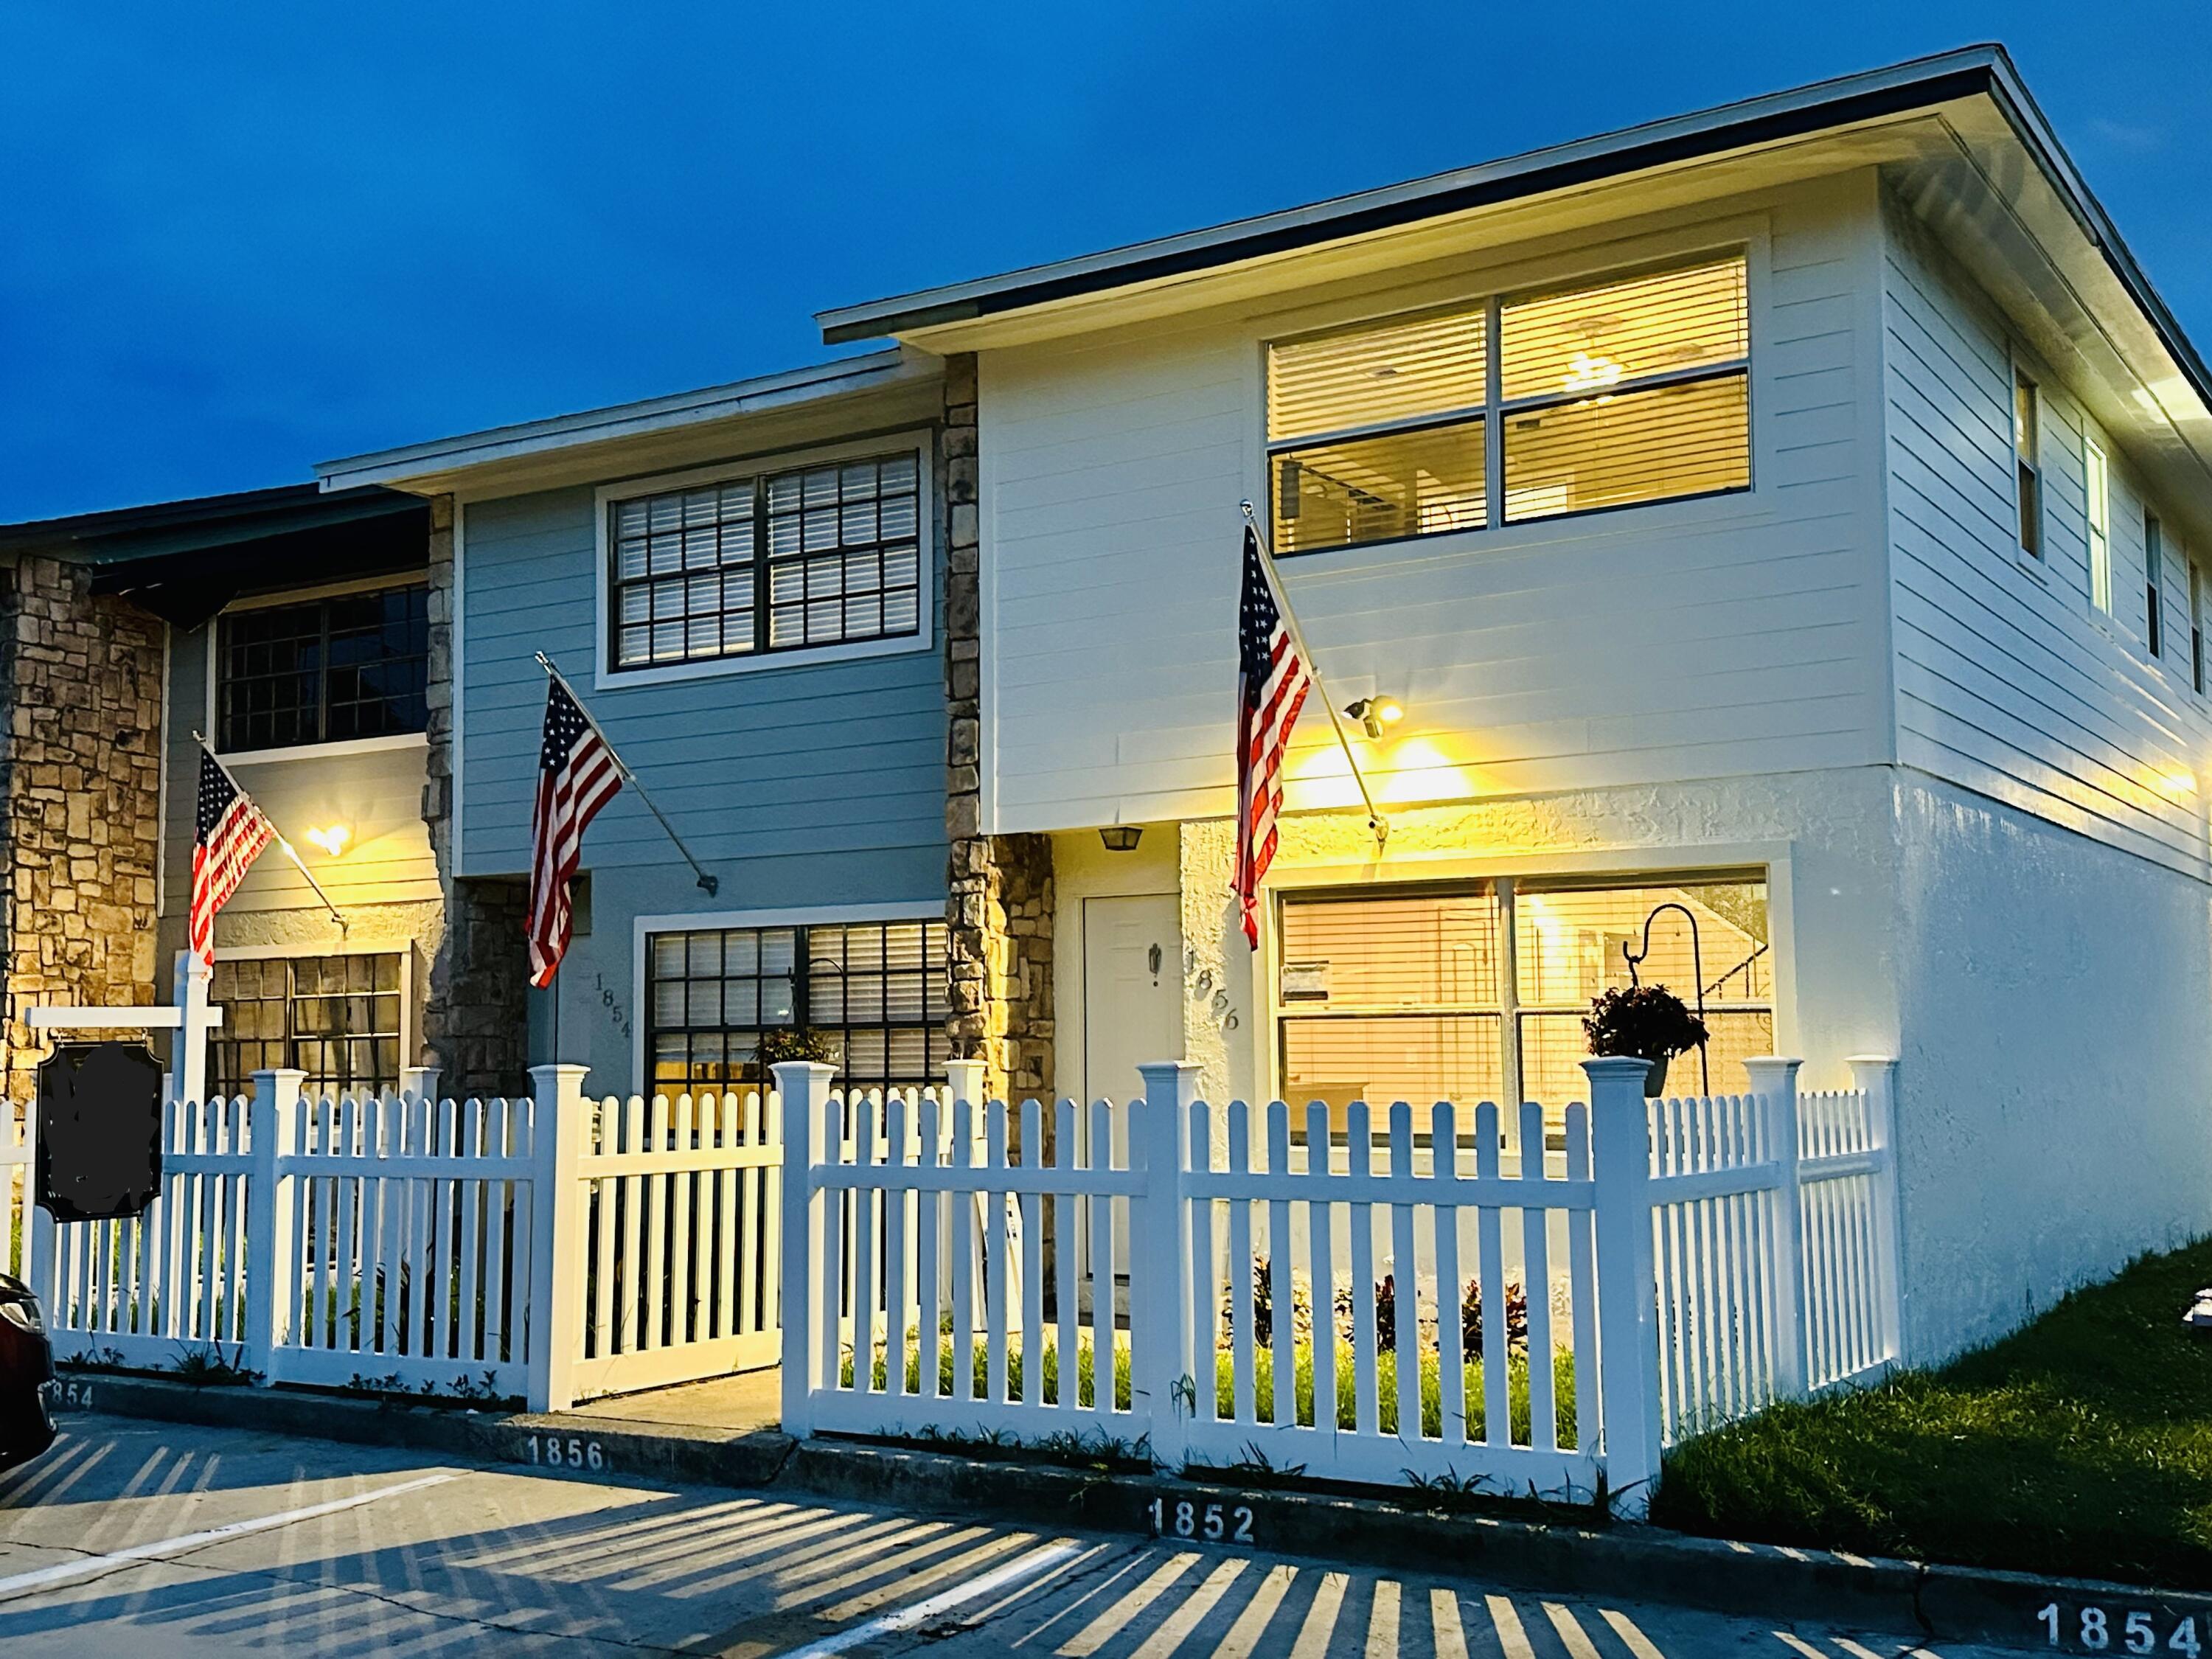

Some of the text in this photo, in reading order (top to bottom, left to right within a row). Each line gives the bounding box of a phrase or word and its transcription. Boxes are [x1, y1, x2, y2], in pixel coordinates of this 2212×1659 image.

[595, 973, 631, 1038] 1854
[1188, 949, 1239, 1030] 1856
[53, 1381, 93, 1409] 854
[528, 1435, 602, 1470] 1856
[1148, 1498, 1253, 1543] 1852
[2037, 1603, 2201, 1659] 1854
